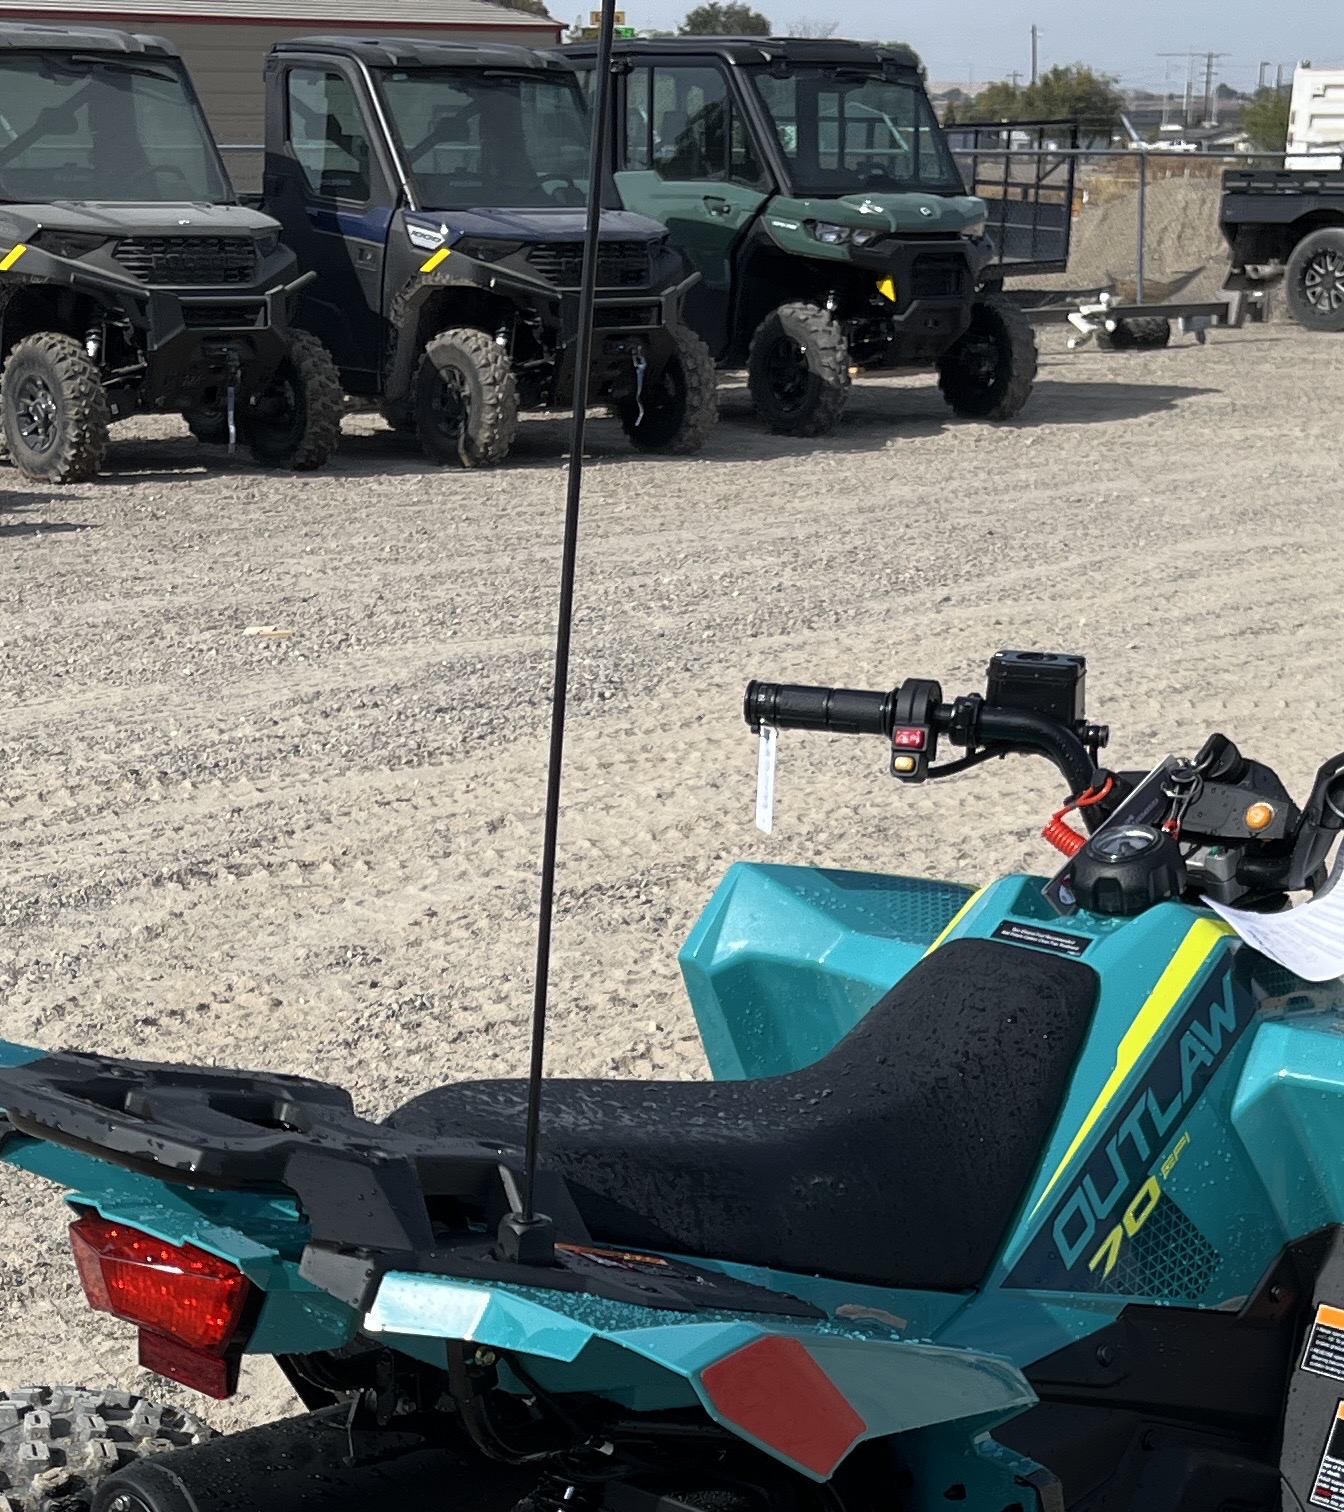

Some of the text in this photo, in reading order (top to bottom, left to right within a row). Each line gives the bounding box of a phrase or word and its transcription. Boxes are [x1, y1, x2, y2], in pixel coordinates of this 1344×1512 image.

[411, 230, 442, 243] 1000
[1053, 968, 1238, 1271] OUTLAW
[1088, 1175, 1161, 1286] 70
